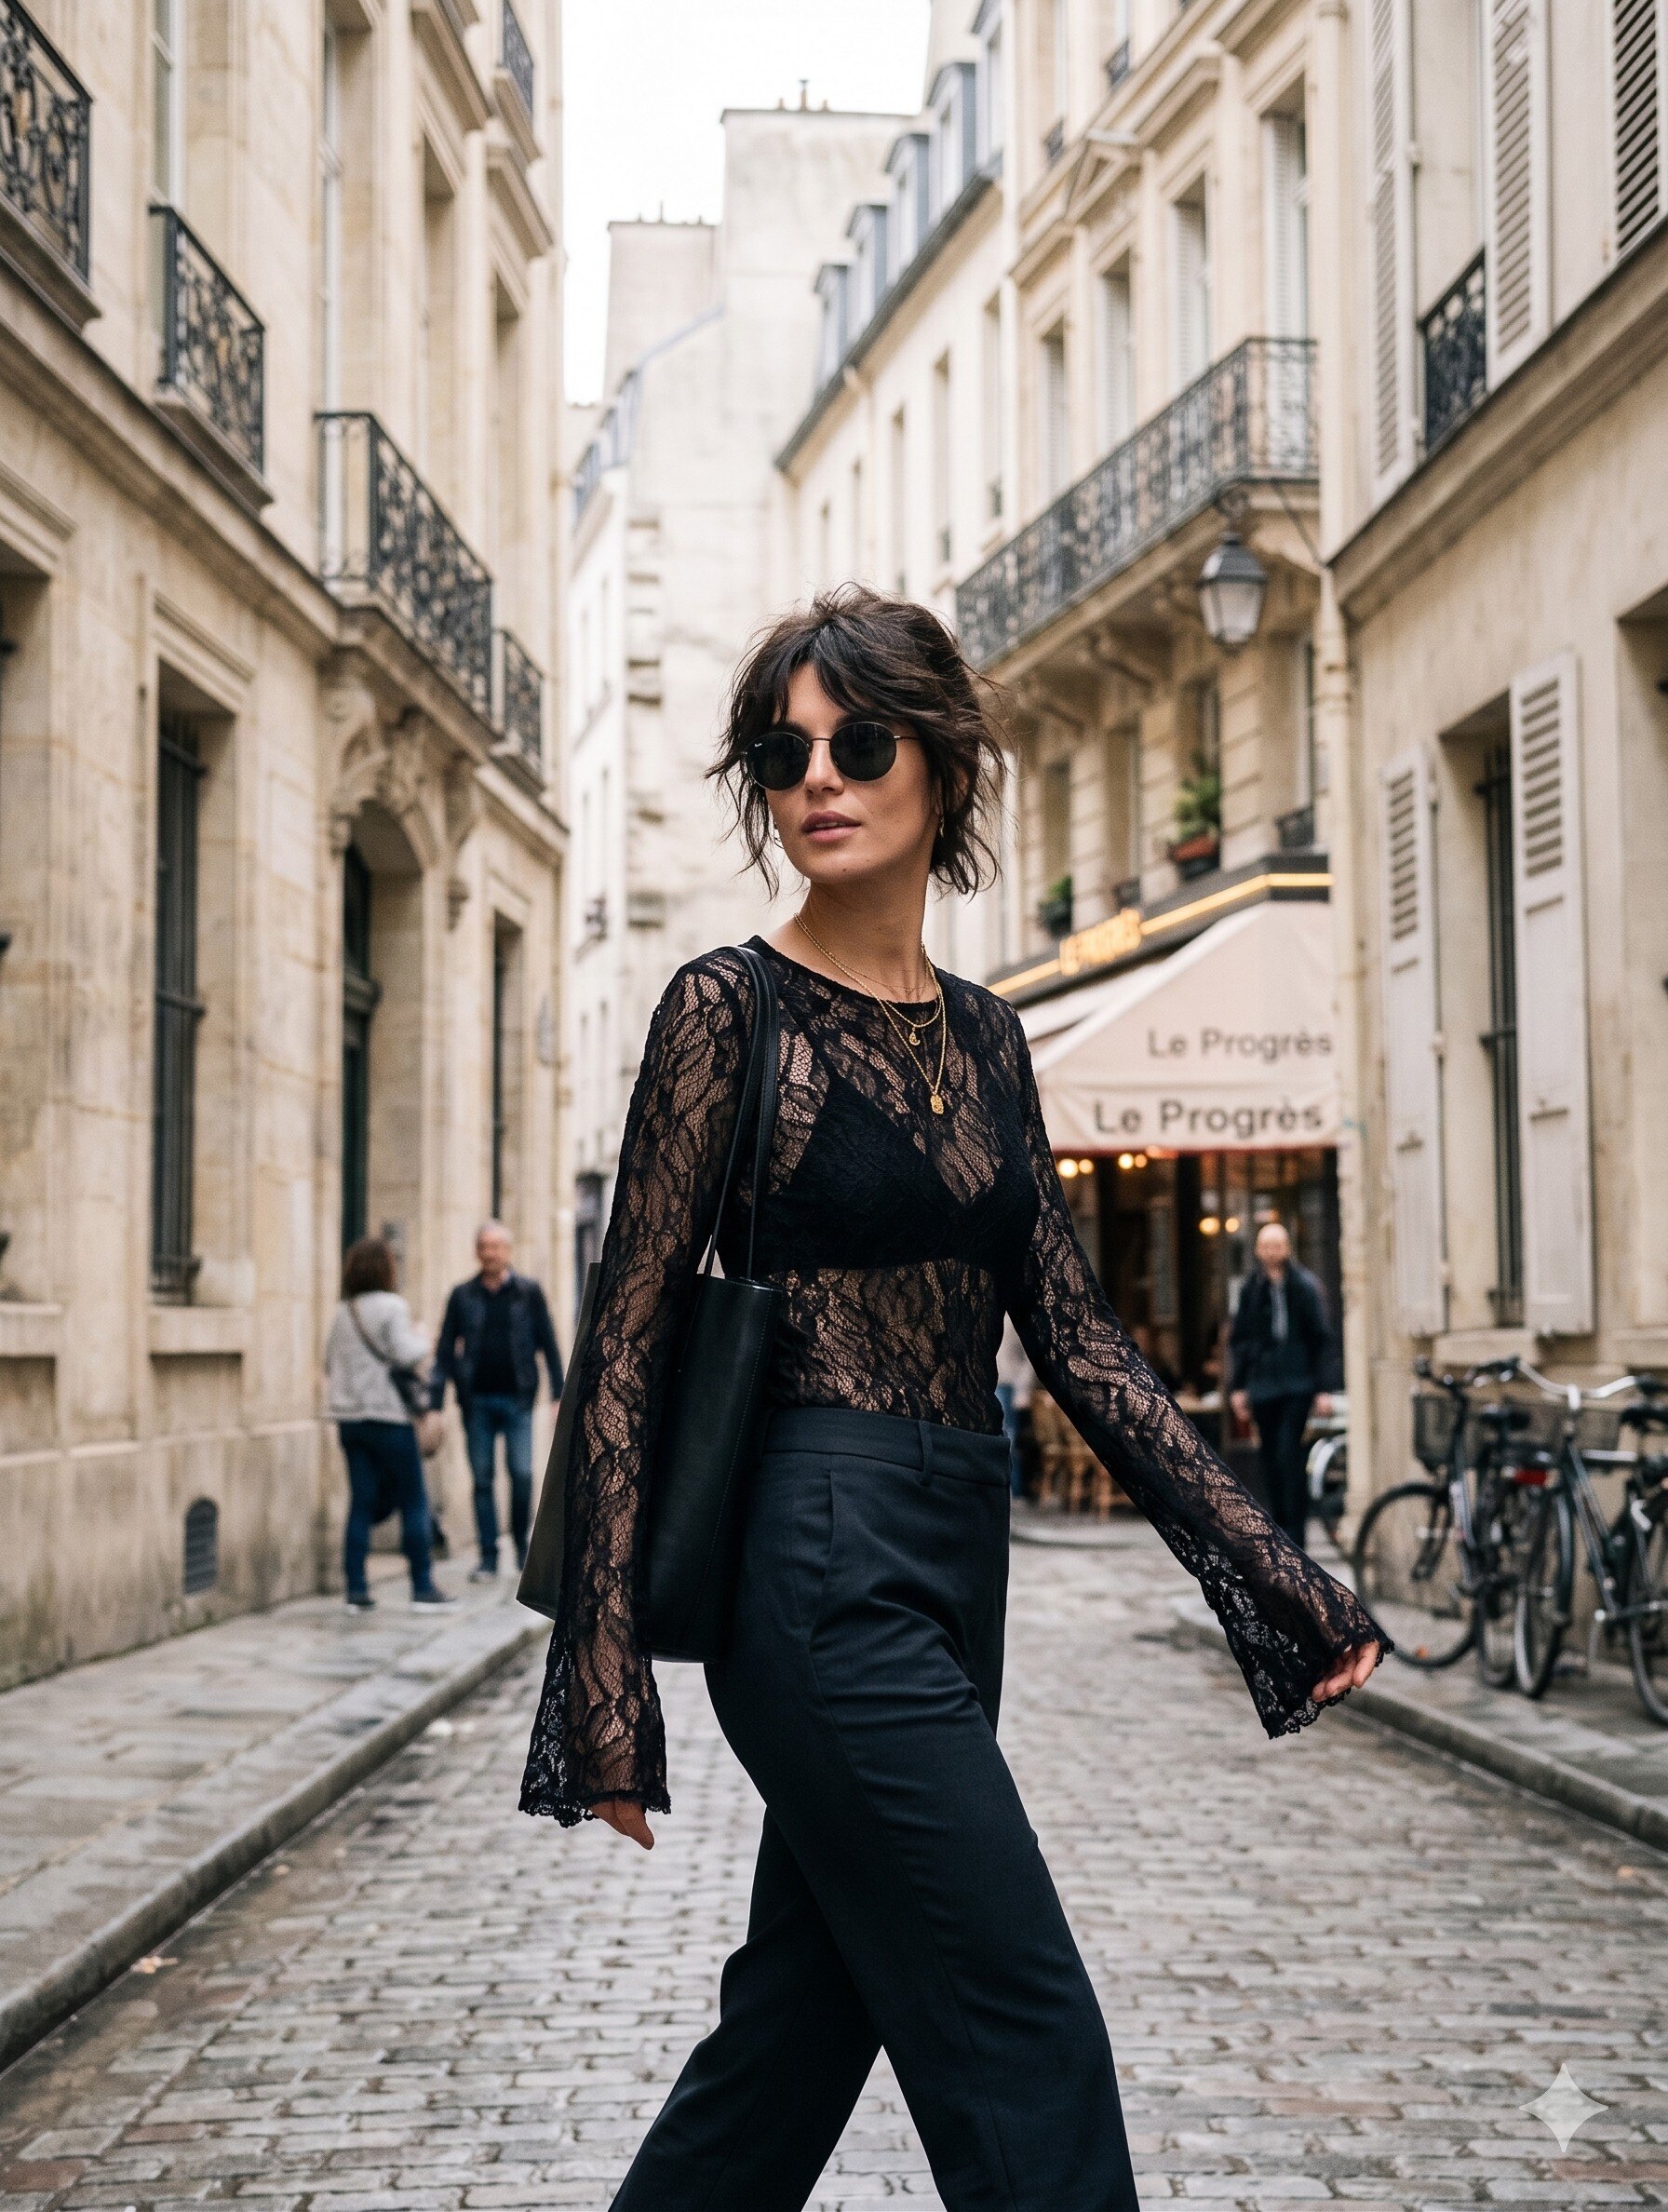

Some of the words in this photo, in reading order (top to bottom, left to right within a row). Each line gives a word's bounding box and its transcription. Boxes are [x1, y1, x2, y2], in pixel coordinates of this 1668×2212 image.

[1149, 1029, 1187, 1058] Le
[1200, 1028, 1332, 1063] Progrès
[1095, 1101, 1141, 1134] Le
[1160, 1098, 1323, 1138] Progrès
